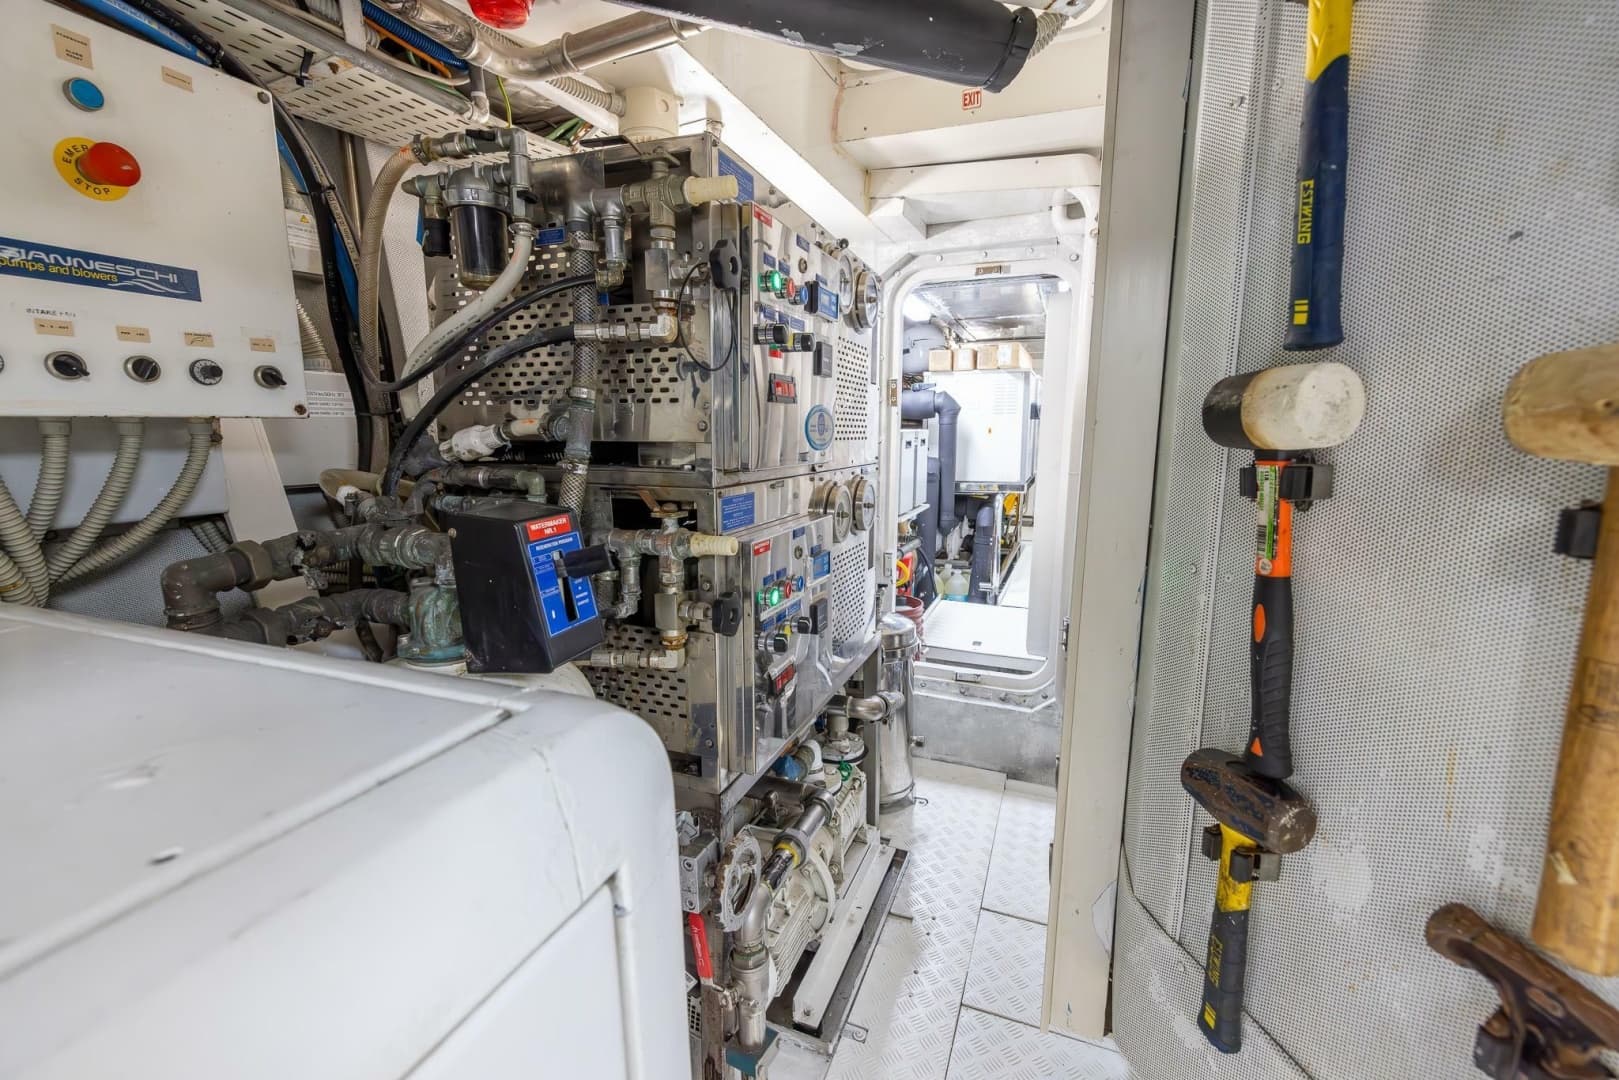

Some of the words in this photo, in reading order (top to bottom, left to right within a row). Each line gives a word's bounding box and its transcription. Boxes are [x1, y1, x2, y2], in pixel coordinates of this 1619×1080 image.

[963, 91, 981, 106] EXIT
[74, 177, 110, 195] STOP
[1297, 180, 1314, 244] ESTWING
[49, 264, 69, 276] and
[72, 266, 118, 282] blowers
[530, 517, 567, 531] WATERMAKER
